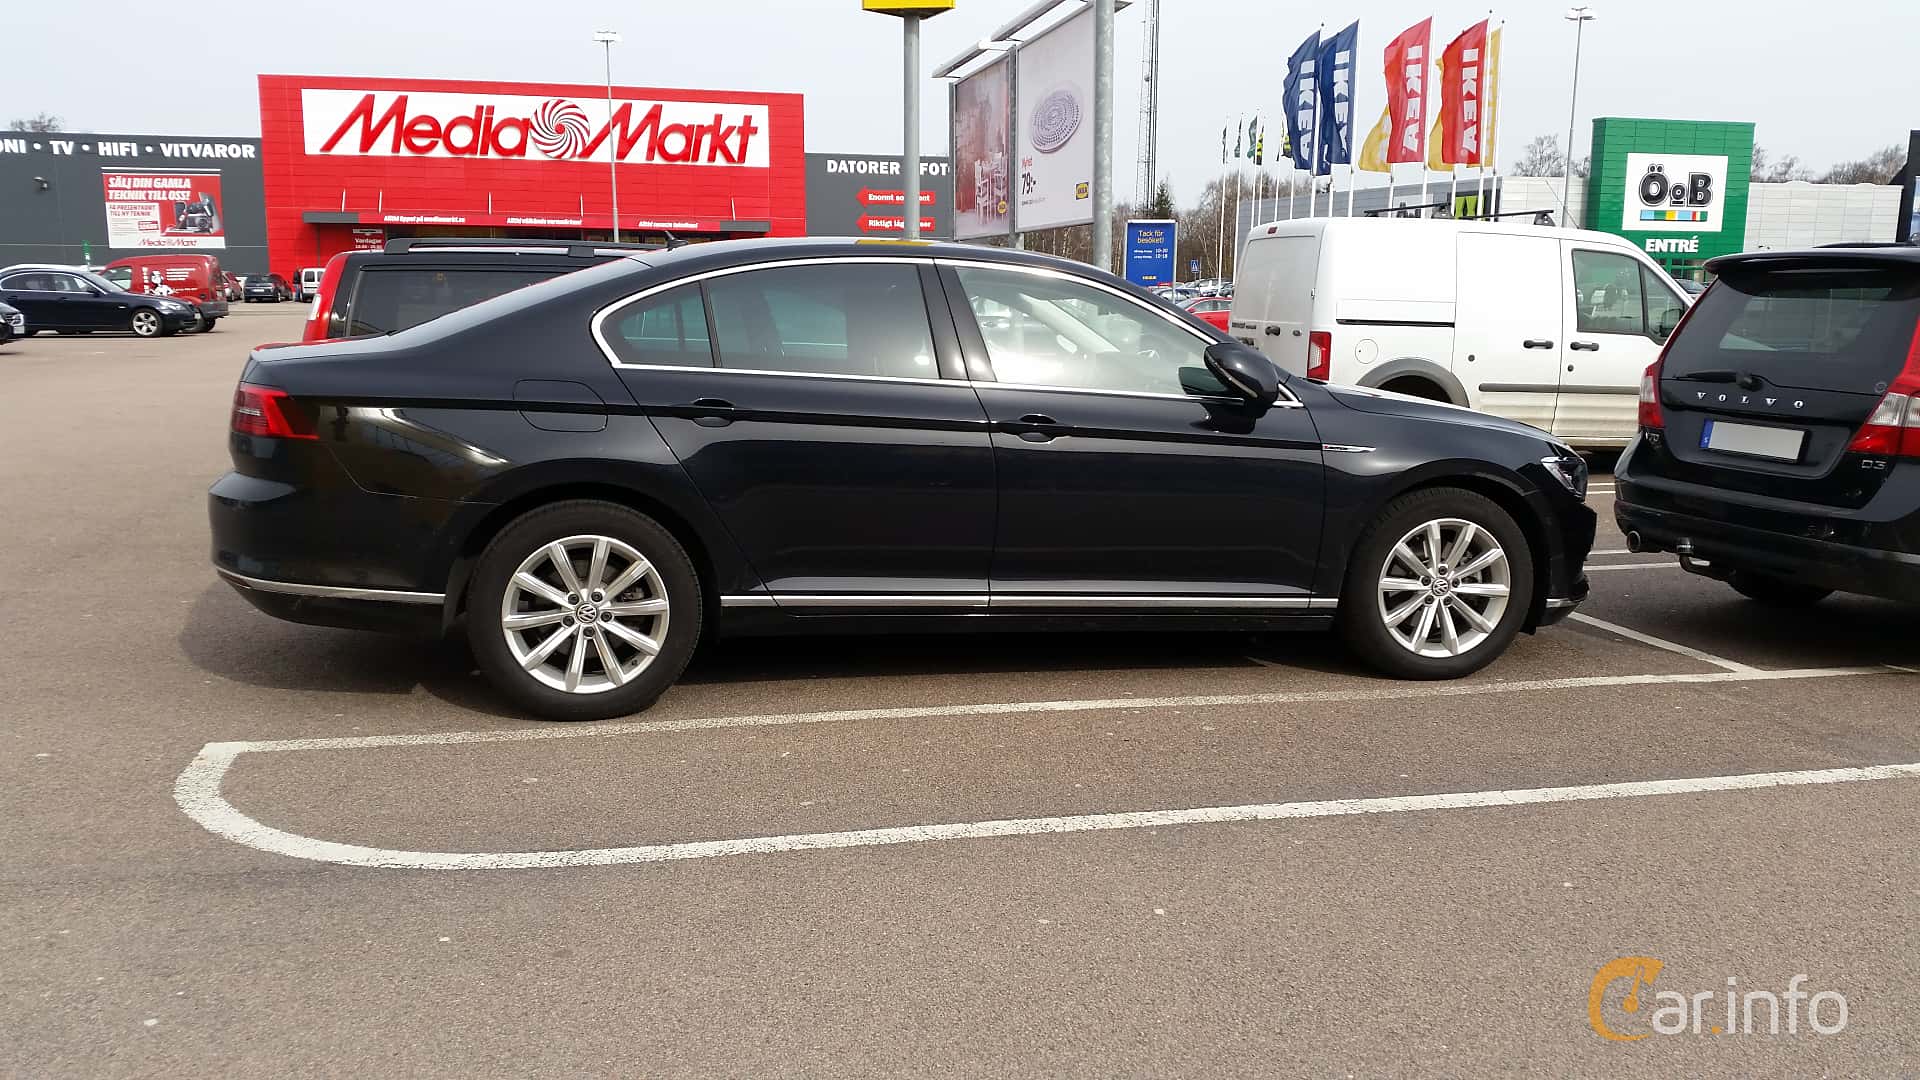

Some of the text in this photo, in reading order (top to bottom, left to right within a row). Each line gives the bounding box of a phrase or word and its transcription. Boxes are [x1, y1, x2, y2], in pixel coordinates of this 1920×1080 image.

[1402, 45, 1423, 153] IKEA
[1462, 48, 1479, 154] IKEA
[320, 94, 758, 164] Media Markt
[49, 140, 74, 155] TV
[97, 141, 139, 157] HIFI
[159, 142, 256, 159] VITVAROR
[826, 159, 950, 176] DATORER FOT
[108, 175, 192, 190] SÄLJ DIN GAMLA
[1638, 163, 1714, 208] ÖoB
[108, 189, 192, 201] TEKNIK TILL OSS!
[868, 193, 894, 201] Enormt
[868, 219, 893, 228] Riktigt
[1645, 235, 1699, 253] ENTRÉ
[1697, 391, 1804, 409] VOLVO
[1861, 460, 1887, 470] D3
